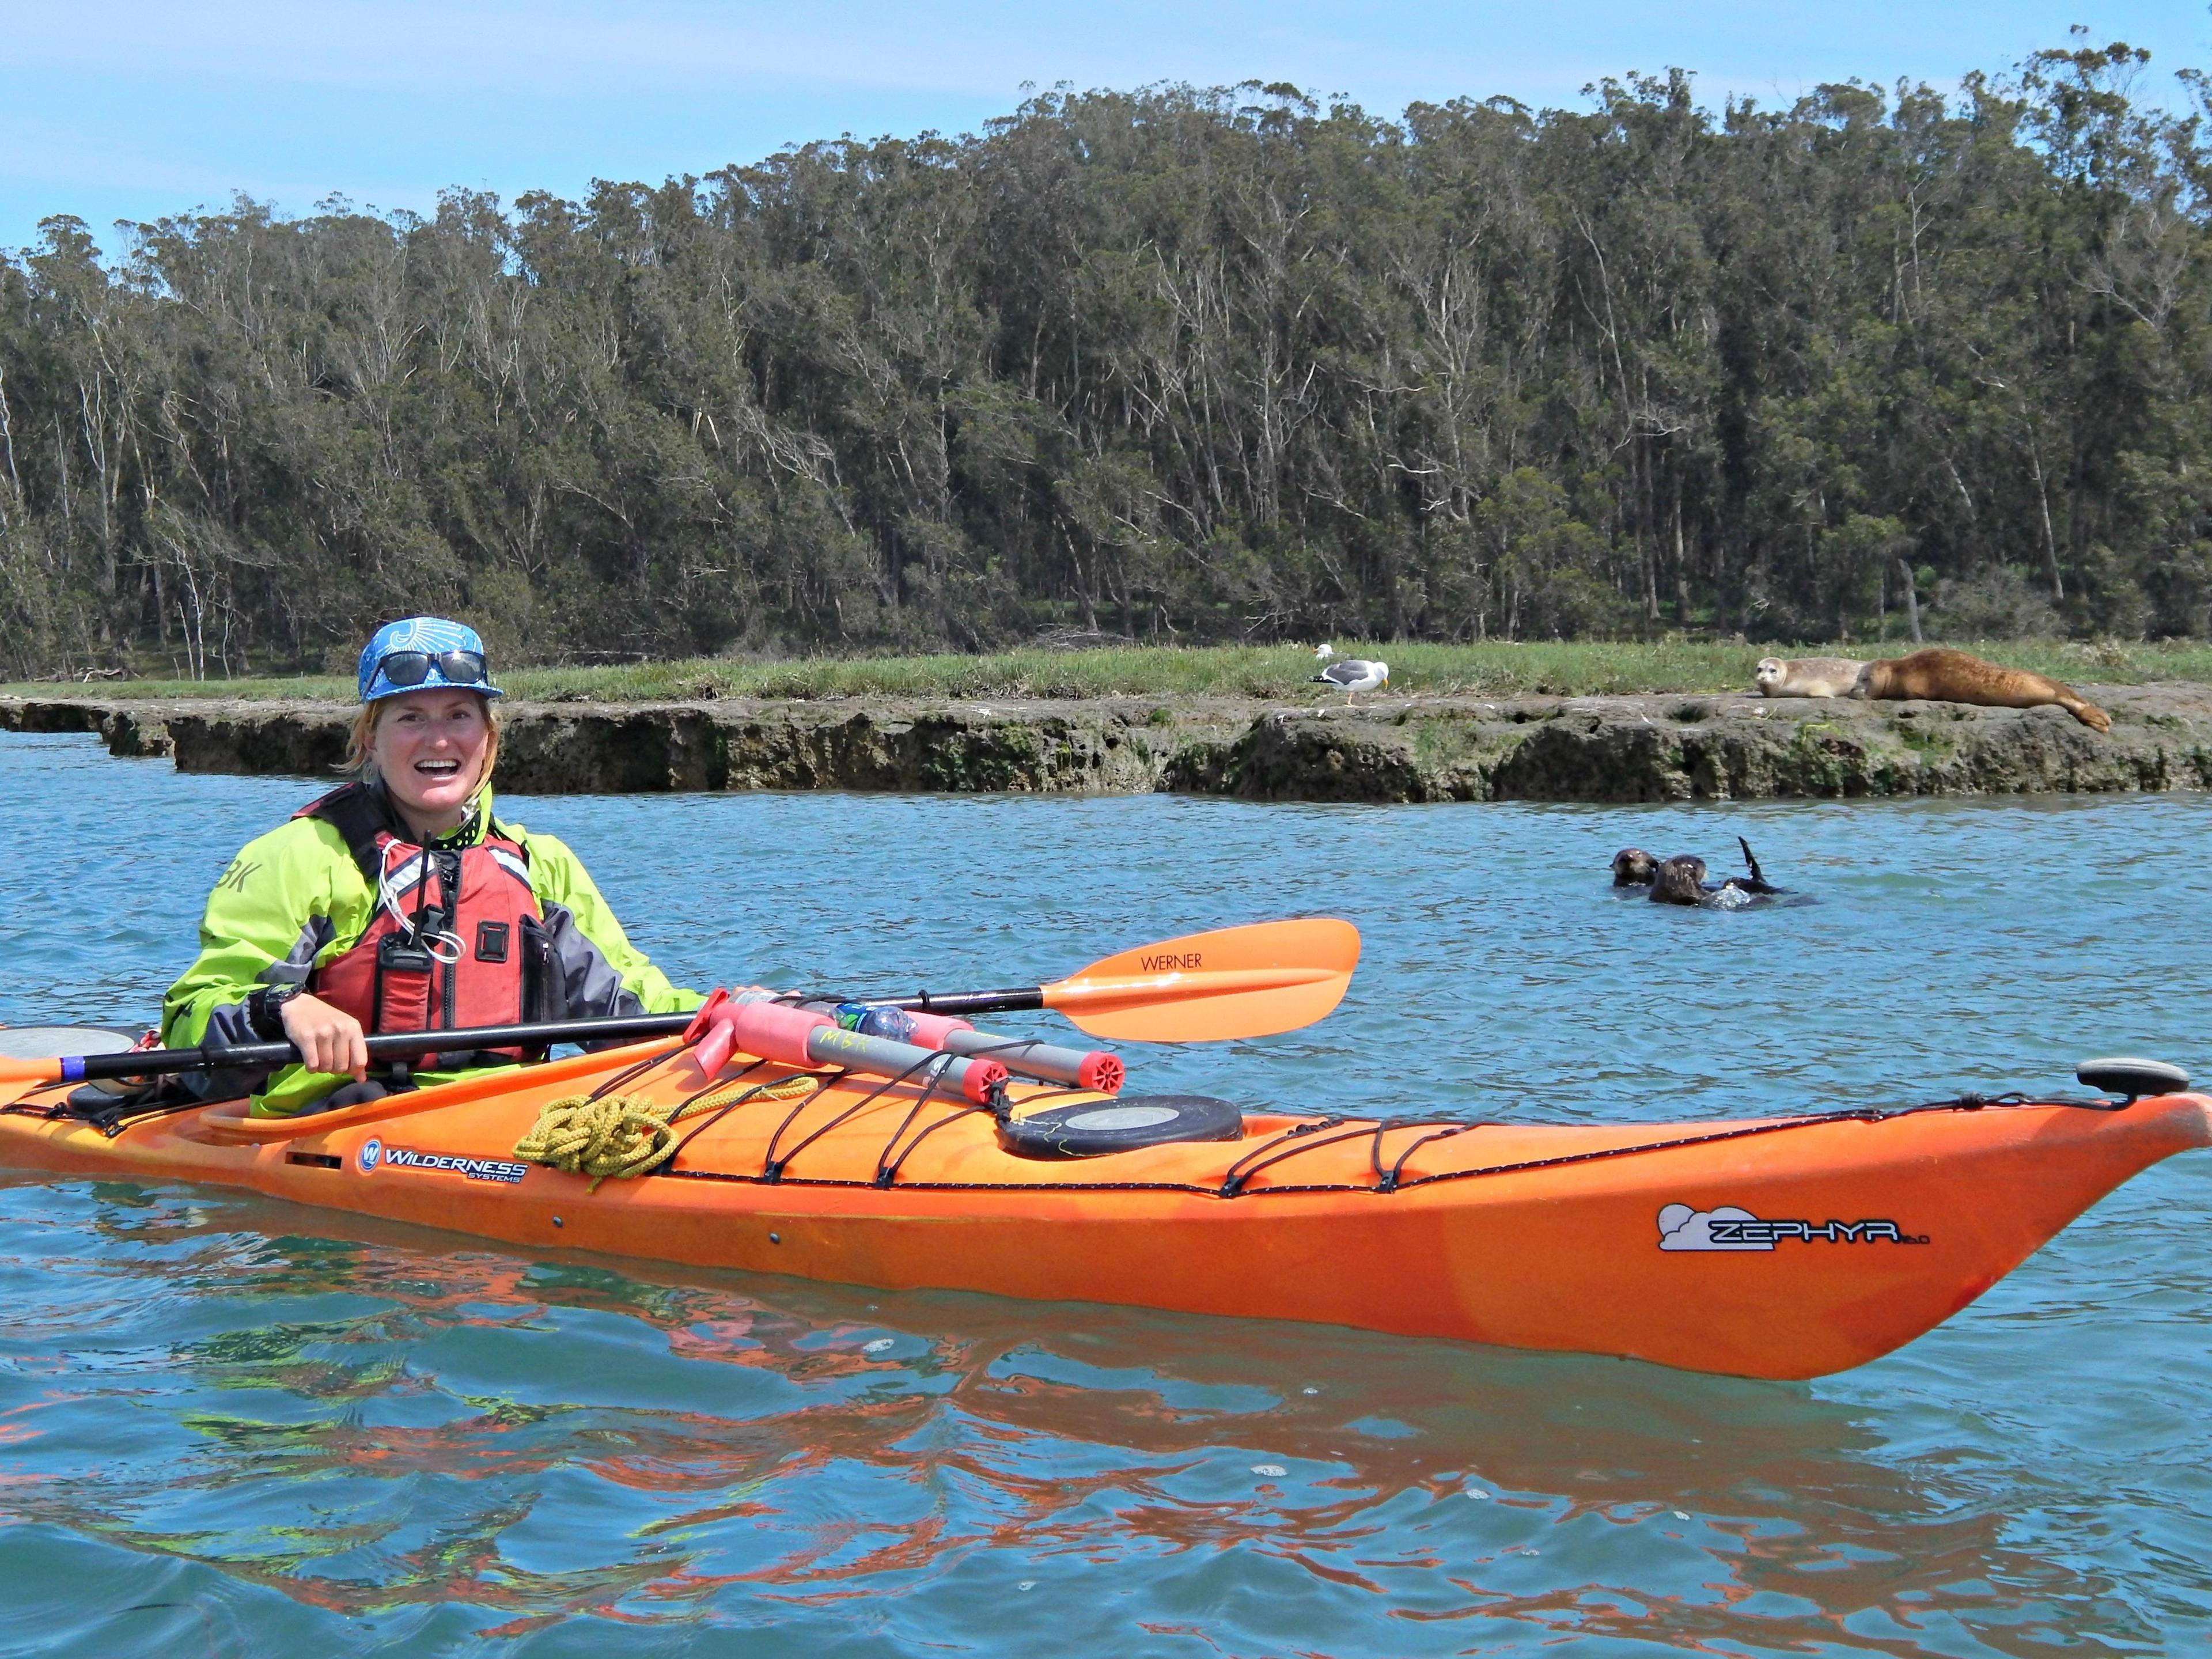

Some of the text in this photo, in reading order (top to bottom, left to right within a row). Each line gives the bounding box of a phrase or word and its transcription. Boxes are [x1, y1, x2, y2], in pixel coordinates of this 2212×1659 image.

[1141, 953, 1202, 972] WERNER
[385, 1149, 528, 1176] WILDERNESS
[467, 1172, 521, 1183] SYSTEMS
[1709, 1220, 1900, 1243] ZEPHYR
